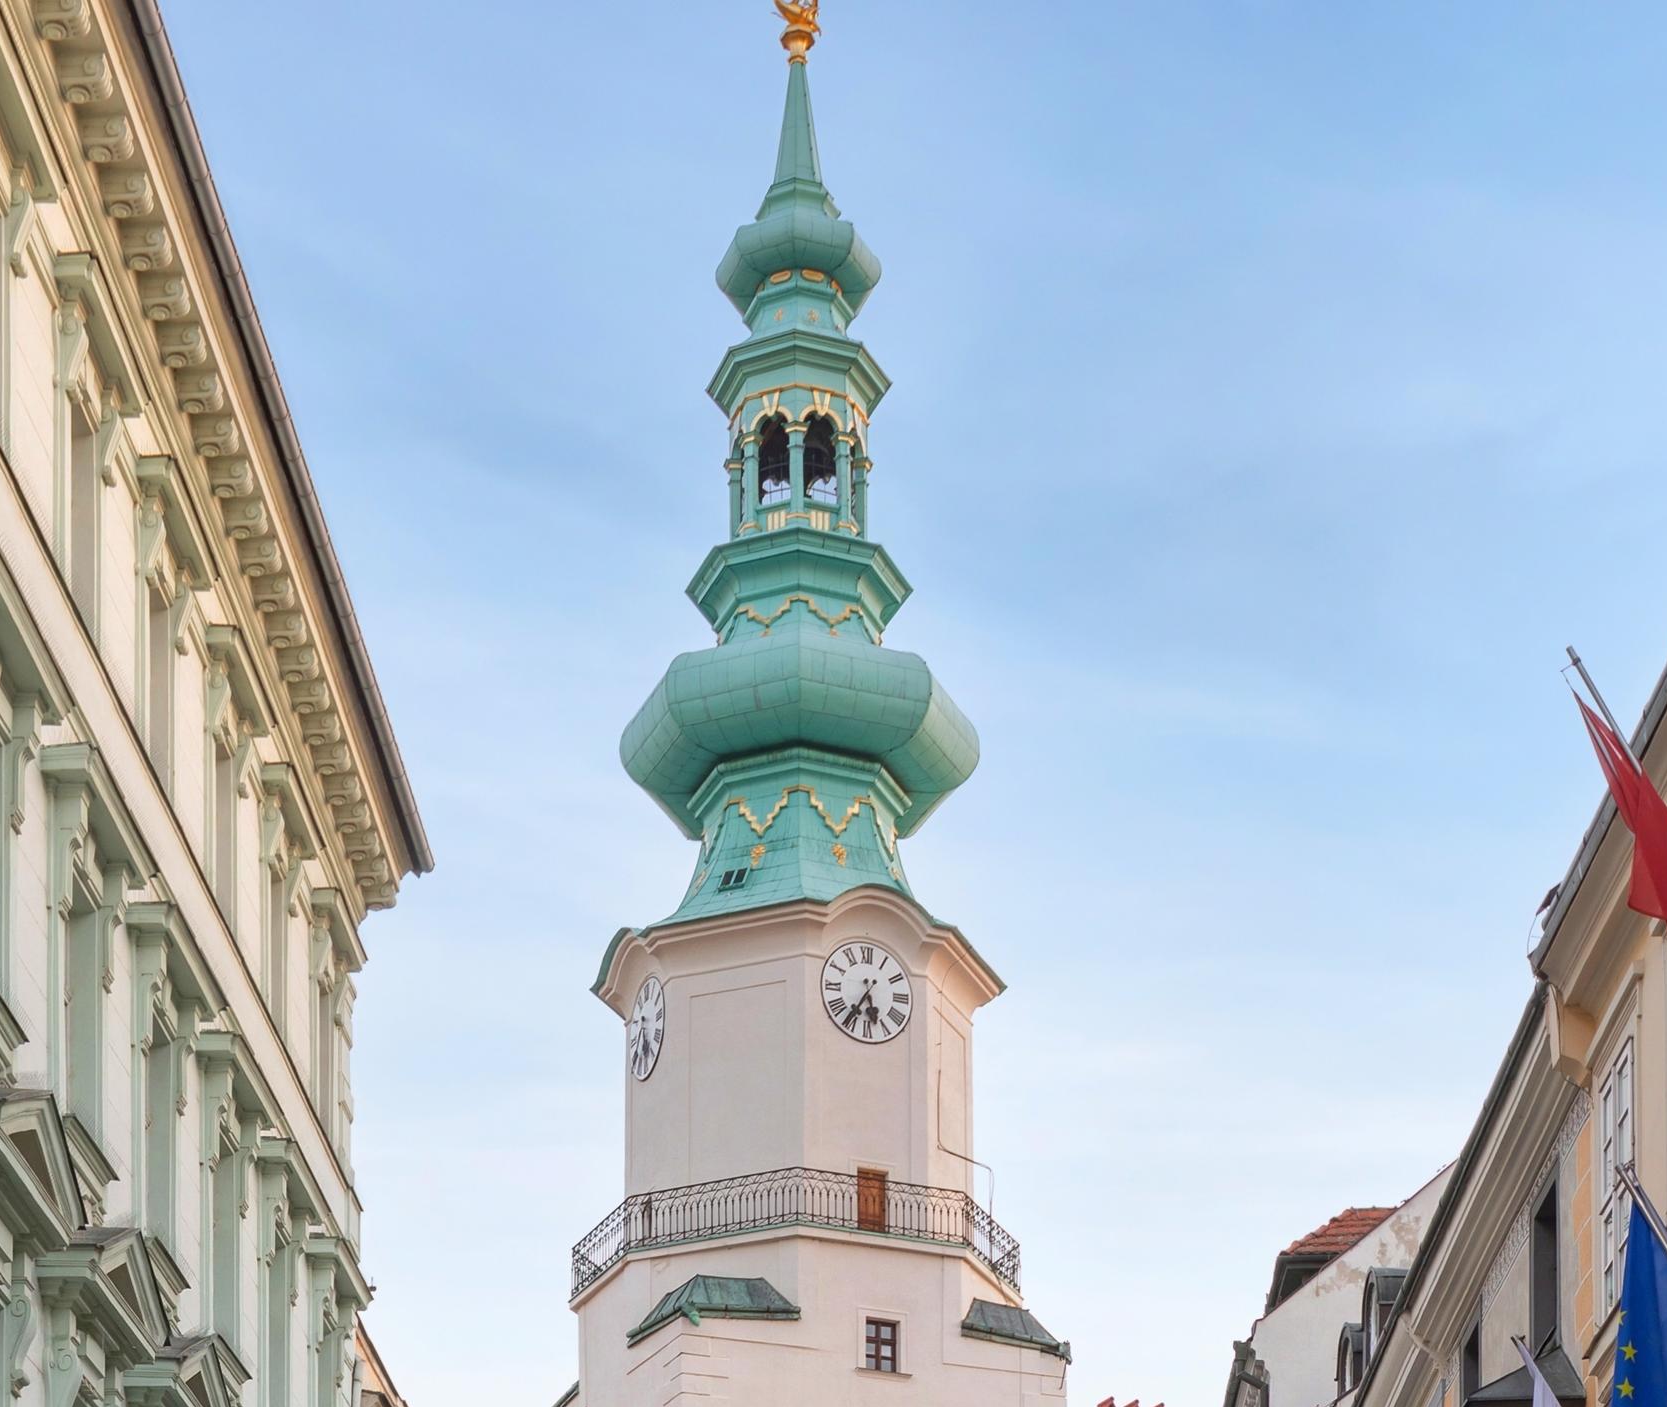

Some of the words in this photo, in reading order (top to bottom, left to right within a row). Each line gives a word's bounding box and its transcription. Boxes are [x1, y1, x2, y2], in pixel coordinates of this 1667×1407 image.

[843, 947, 858, 967] XI
[860, 946, 874, 965] XII
[879, 956, 889, 970] I
[829, 960, 846, 976] X
[825, 979, 841, 992] IX
[888, 973, 904, 985] II
[893, 992, 909, 1005] III
[828, 997, 848, 1018] VIII
